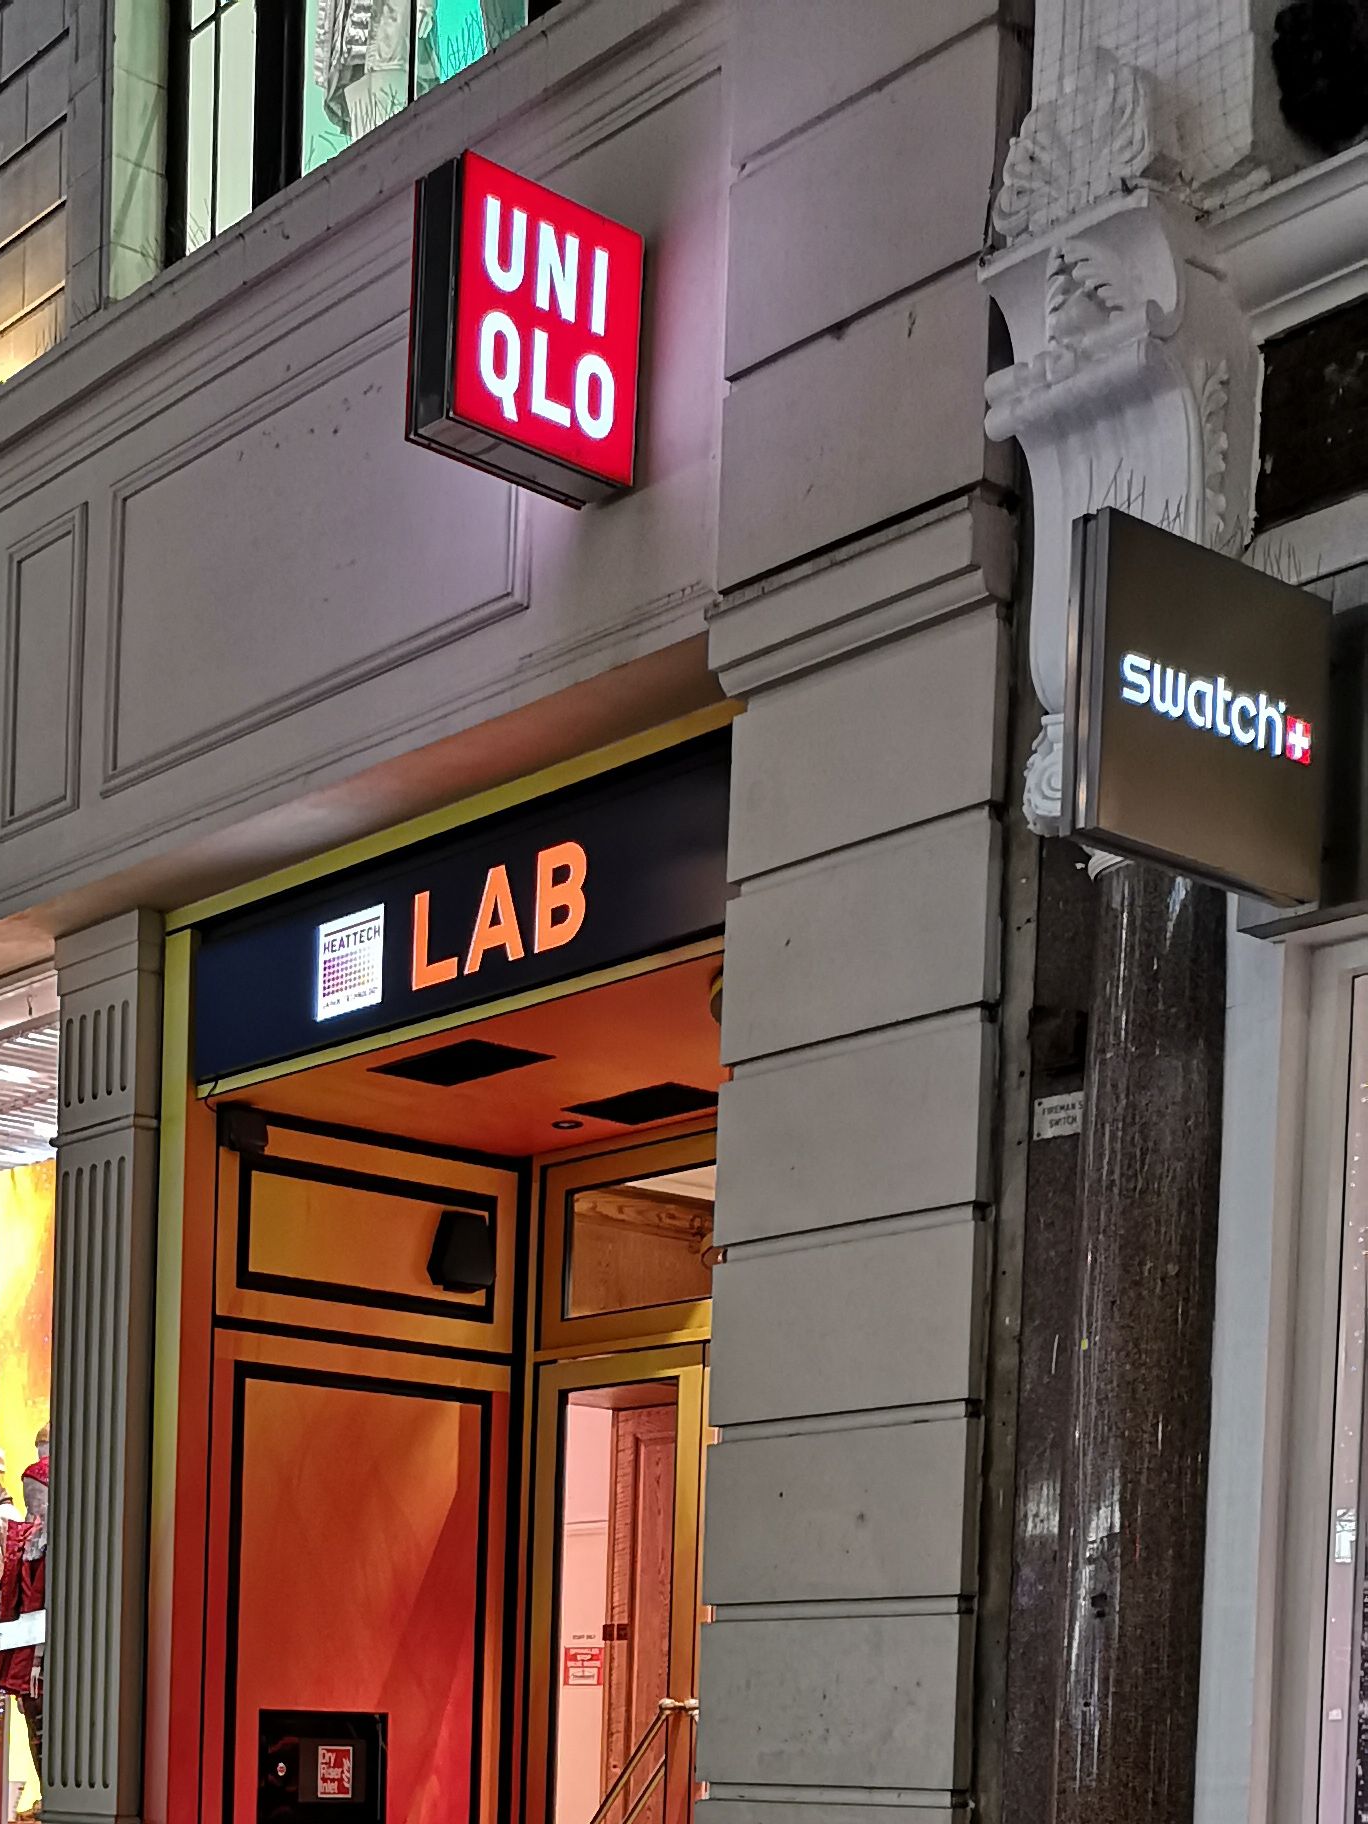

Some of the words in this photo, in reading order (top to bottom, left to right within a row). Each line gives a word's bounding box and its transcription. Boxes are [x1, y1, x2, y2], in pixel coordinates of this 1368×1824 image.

[483, 193, 610, 337] UNI
[480, 308, 616, 440] QLO
[1120, 652, 1283, 757] swatch
[323, 924, 381, 954] HEATTECH
[410, 840, 588, 993] LAB
[320, 1749, 336, 1767] Dry
